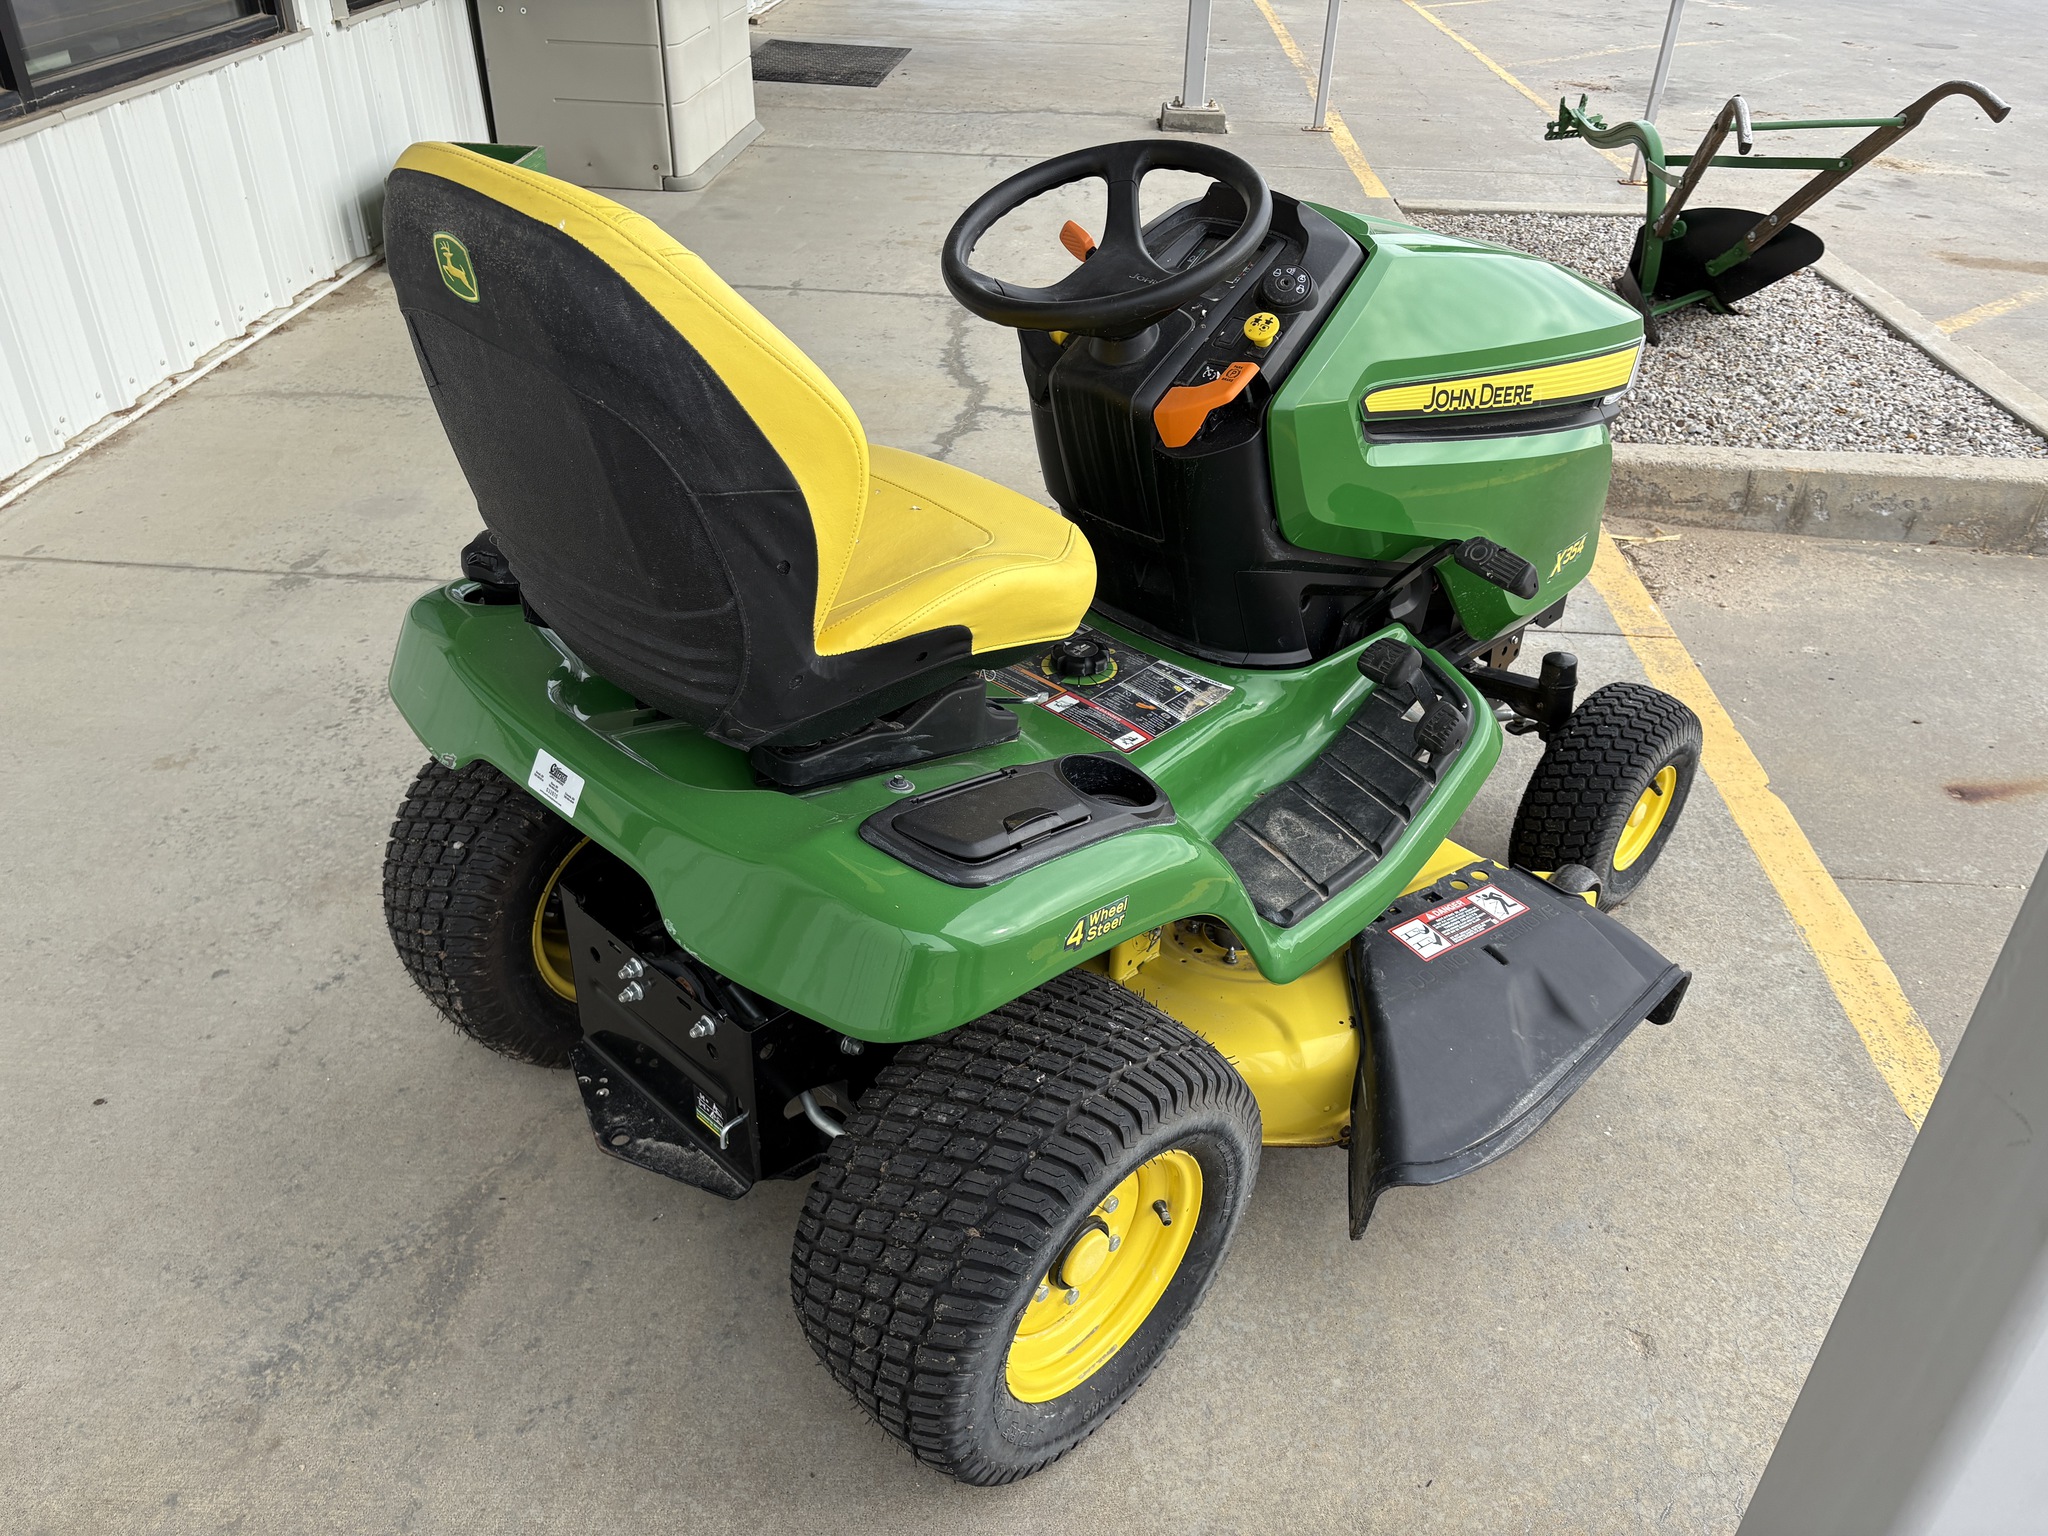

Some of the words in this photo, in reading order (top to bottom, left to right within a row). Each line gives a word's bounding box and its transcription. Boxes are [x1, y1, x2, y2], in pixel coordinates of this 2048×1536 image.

[1423, 385, 1476, 411] JOHN
[1479, 383, 1535, 406] DEERE
[1549, 536, 1588, 579] X354
[1066, 919, 1085, 947] 4
[1088, 897, 1129, 927] Wheel
[1431, 899, 1466, 917] DANGER
[1086, 913, 1126, 942] Steer
[1406, 967, 1438, 991] DO
[1441, 945, 1478, 975] NOT
[1492, 904, 1561, 945] REMOVE
